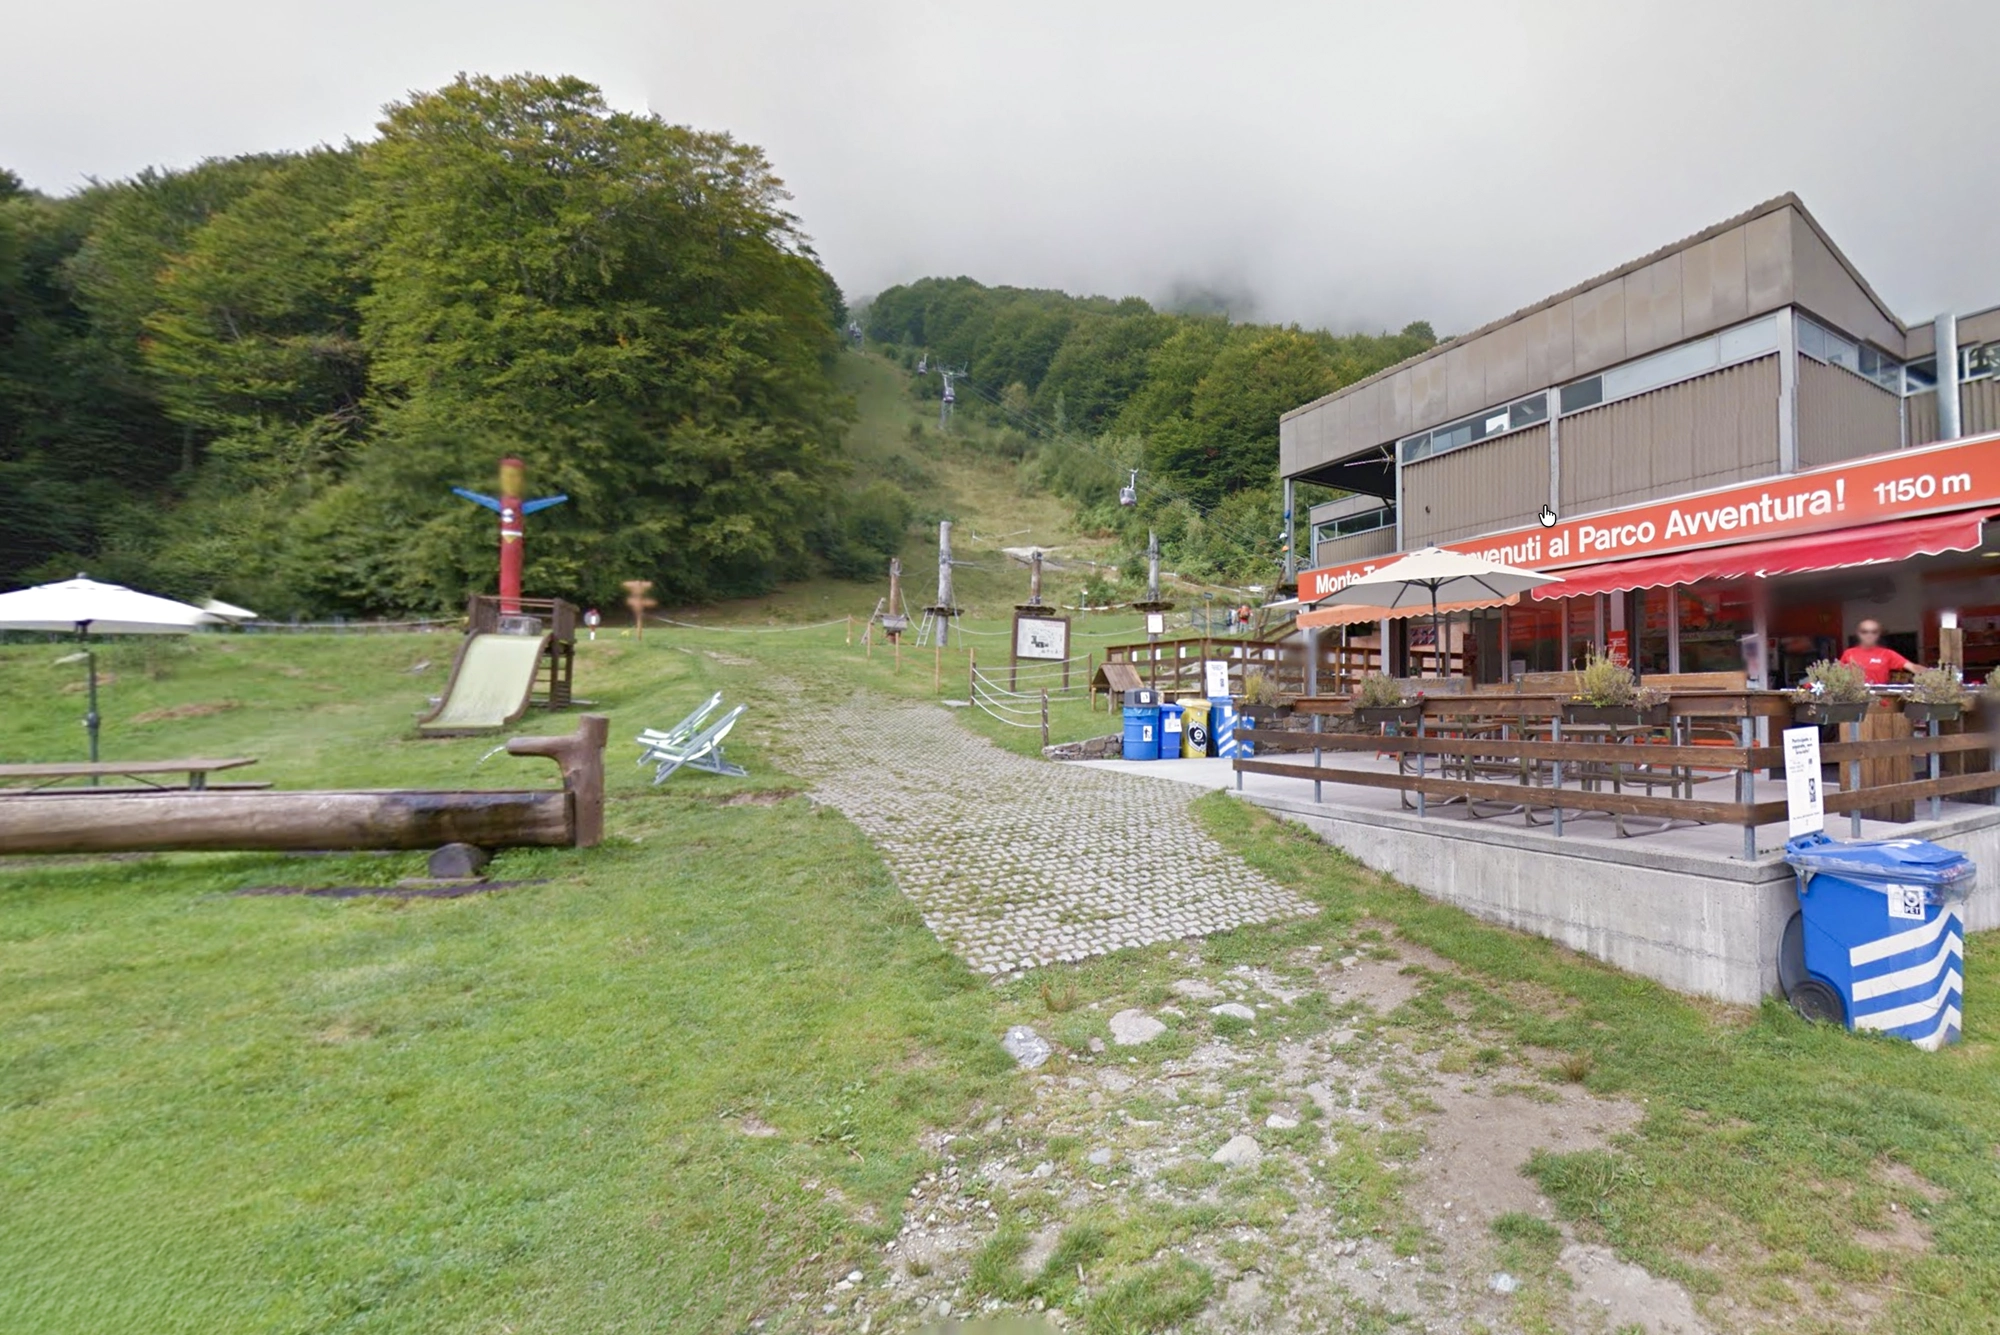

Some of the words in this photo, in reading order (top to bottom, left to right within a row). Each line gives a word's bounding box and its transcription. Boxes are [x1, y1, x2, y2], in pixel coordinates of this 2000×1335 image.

[1873, 474, 1936, 505] 1150
[1942, 473, 1971, 495] m
[1548, 530, 1569, 559] al
[1579, 521, 1657, 553] Parco
[1665, 478, 1845, 540] Avventura!
[1905, 906, 1920, 915] PET
